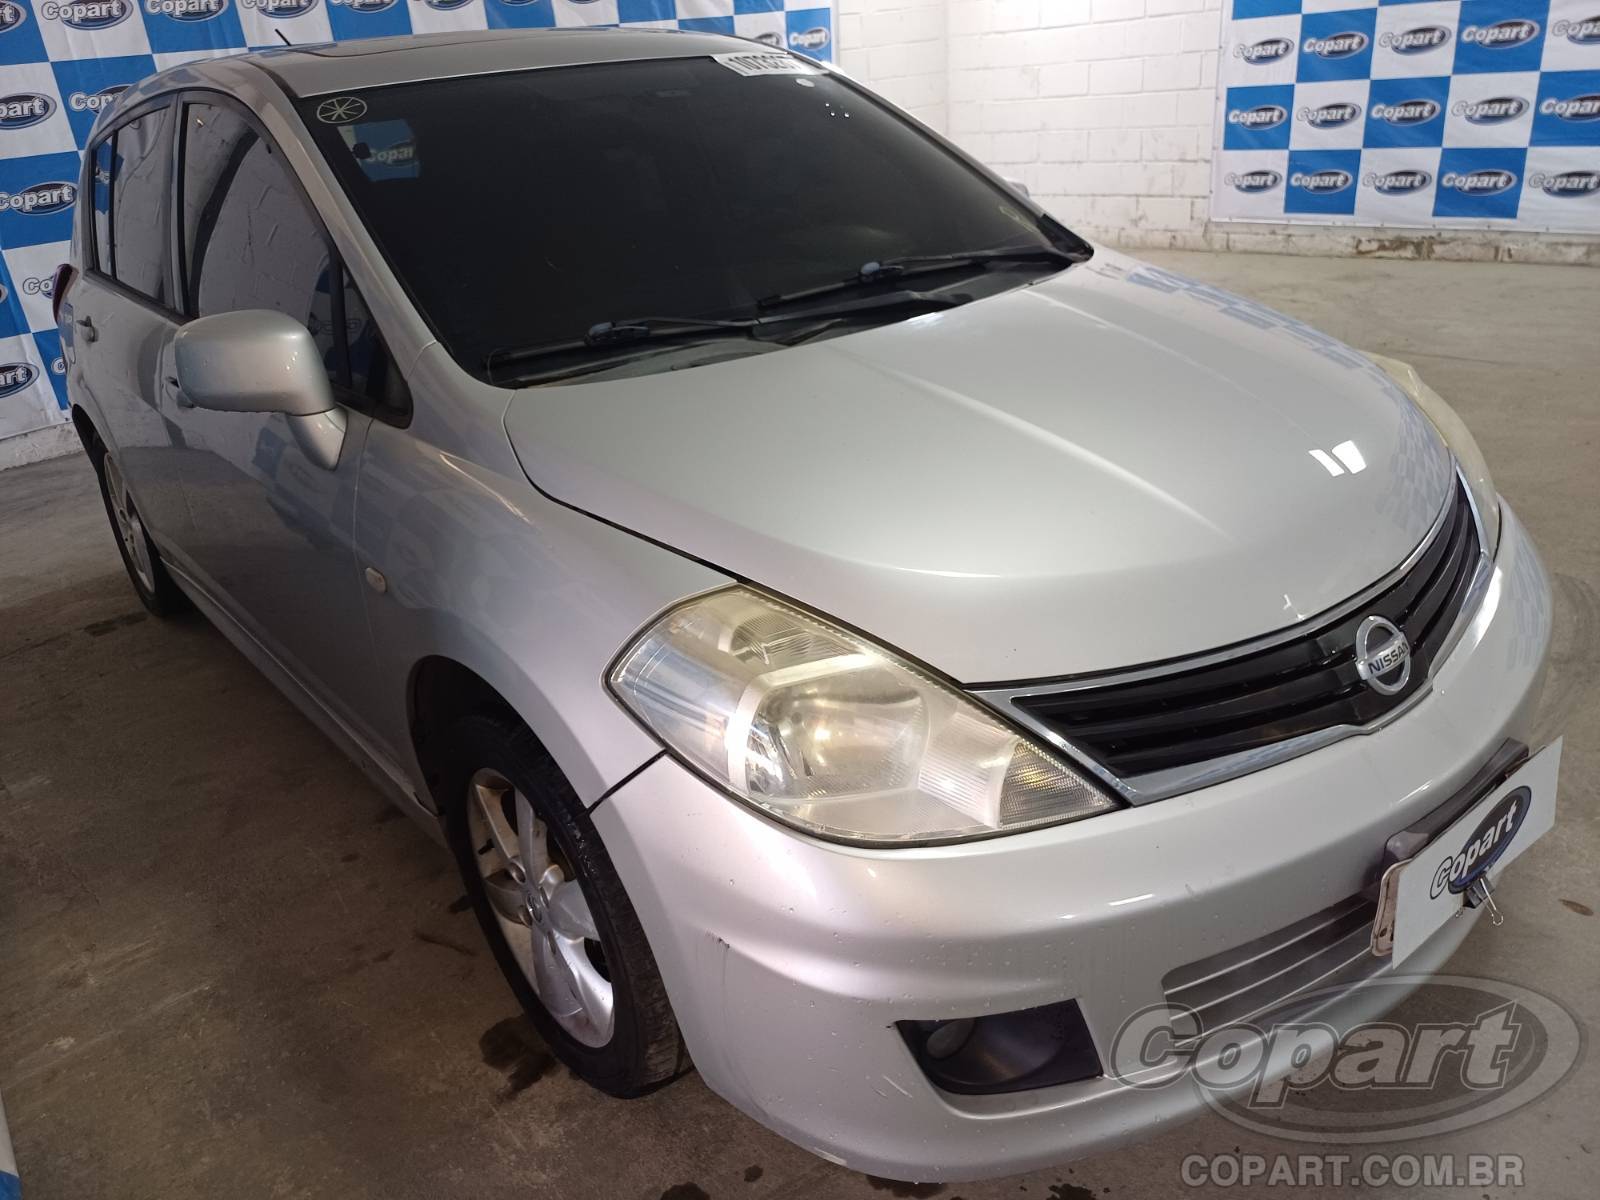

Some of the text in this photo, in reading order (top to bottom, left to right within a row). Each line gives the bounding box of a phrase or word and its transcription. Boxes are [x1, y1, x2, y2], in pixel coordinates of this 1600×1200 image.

[42, 0, 122, 23] Copart
[1304, 32, 1362, 56] Copart
[1380, 28, 1442, 52] Copart
[1462, 23, 1530, 45] Copart
[1234, 41, 1289, 59] Copart
[1229, 107, 1281, 127] Copart
[1297, 105, 1352, 126] Copart
[1371, 102, 1433, 122] Copart
[1451, 99, 1519, 120] Copart
[1540, 98, 1600, 117] Copar
[1225, 171, 1275, 190] Copart
[1290, 172, 1345, 190] Copart
[1363, 171, 1423, 191] Copart
[1442, 171, 1509, 191] Copart
[1529, 174, 1597, 191] Copart
[1368, 642, 1408, 674] NISSAN
[1430, 800, 1517, 899] Copart
